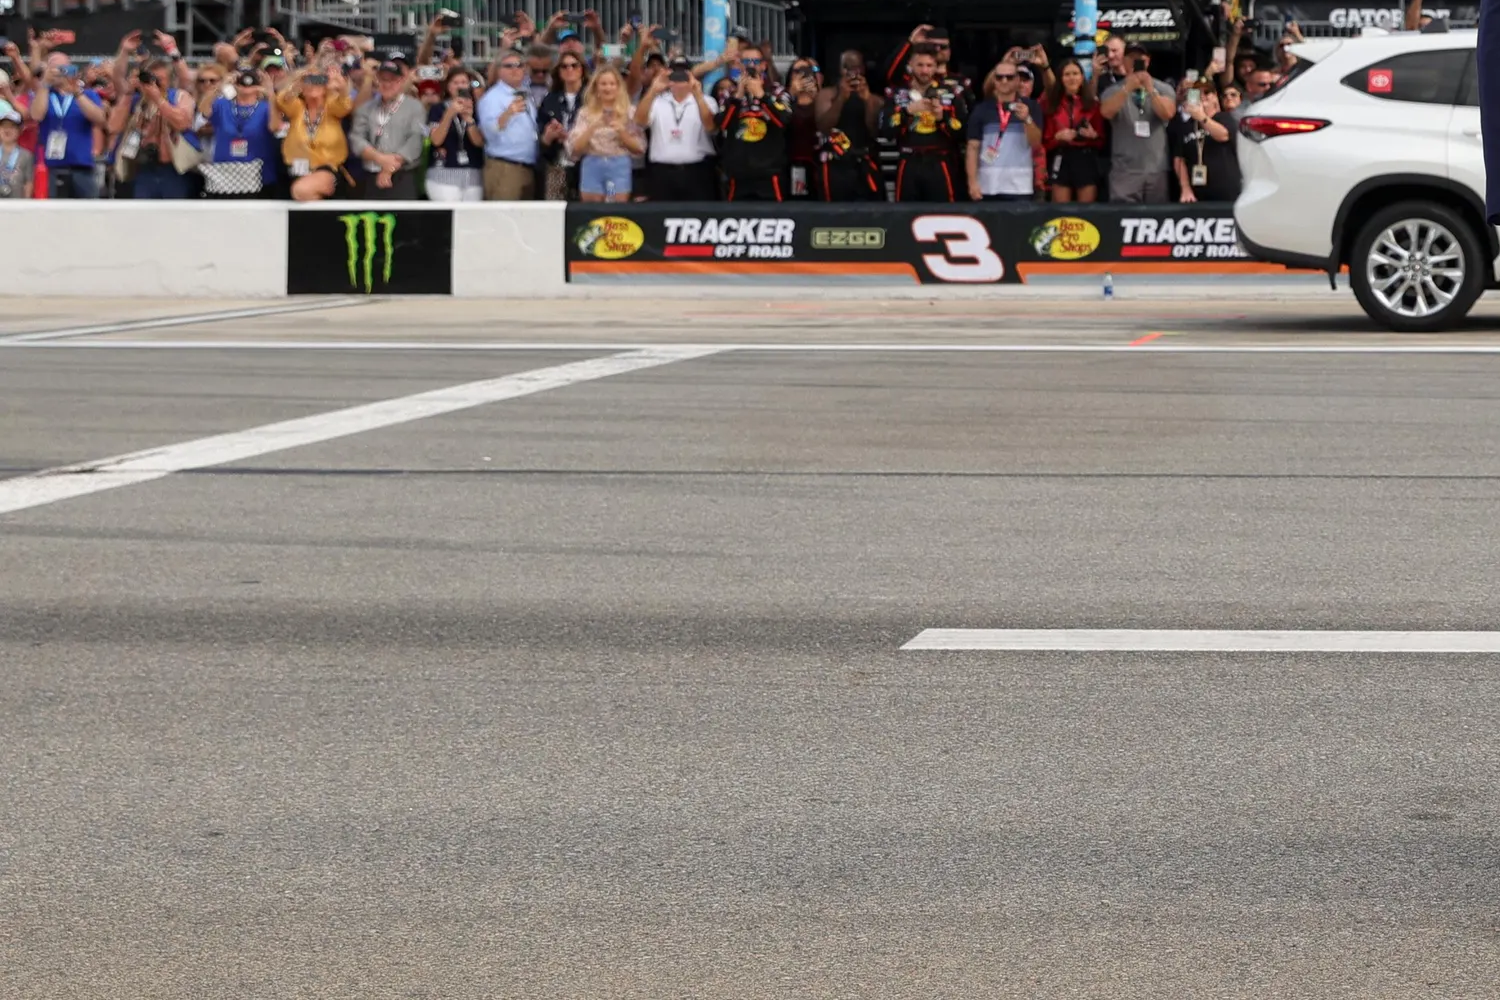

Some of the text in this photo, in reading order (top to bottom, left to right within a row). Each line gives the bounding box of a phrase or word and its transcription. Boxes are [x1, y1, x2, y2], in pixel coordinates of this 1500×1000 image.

[604, 218, 629, 231] Bass
[664, 218, 796, 244] TRACKER
[1060, 218, 1085, 231] Bass
[1120, 218, 1237, 243] TRACKE
[603, 240, 636, 254] Shops
[715, 245, 794, 258] OFF ROAD
[911, 215, 1004, 283] 3
[1060, 240, 1093, 254] Shops
[1172, 245, 1251, 258] OFF ROA
